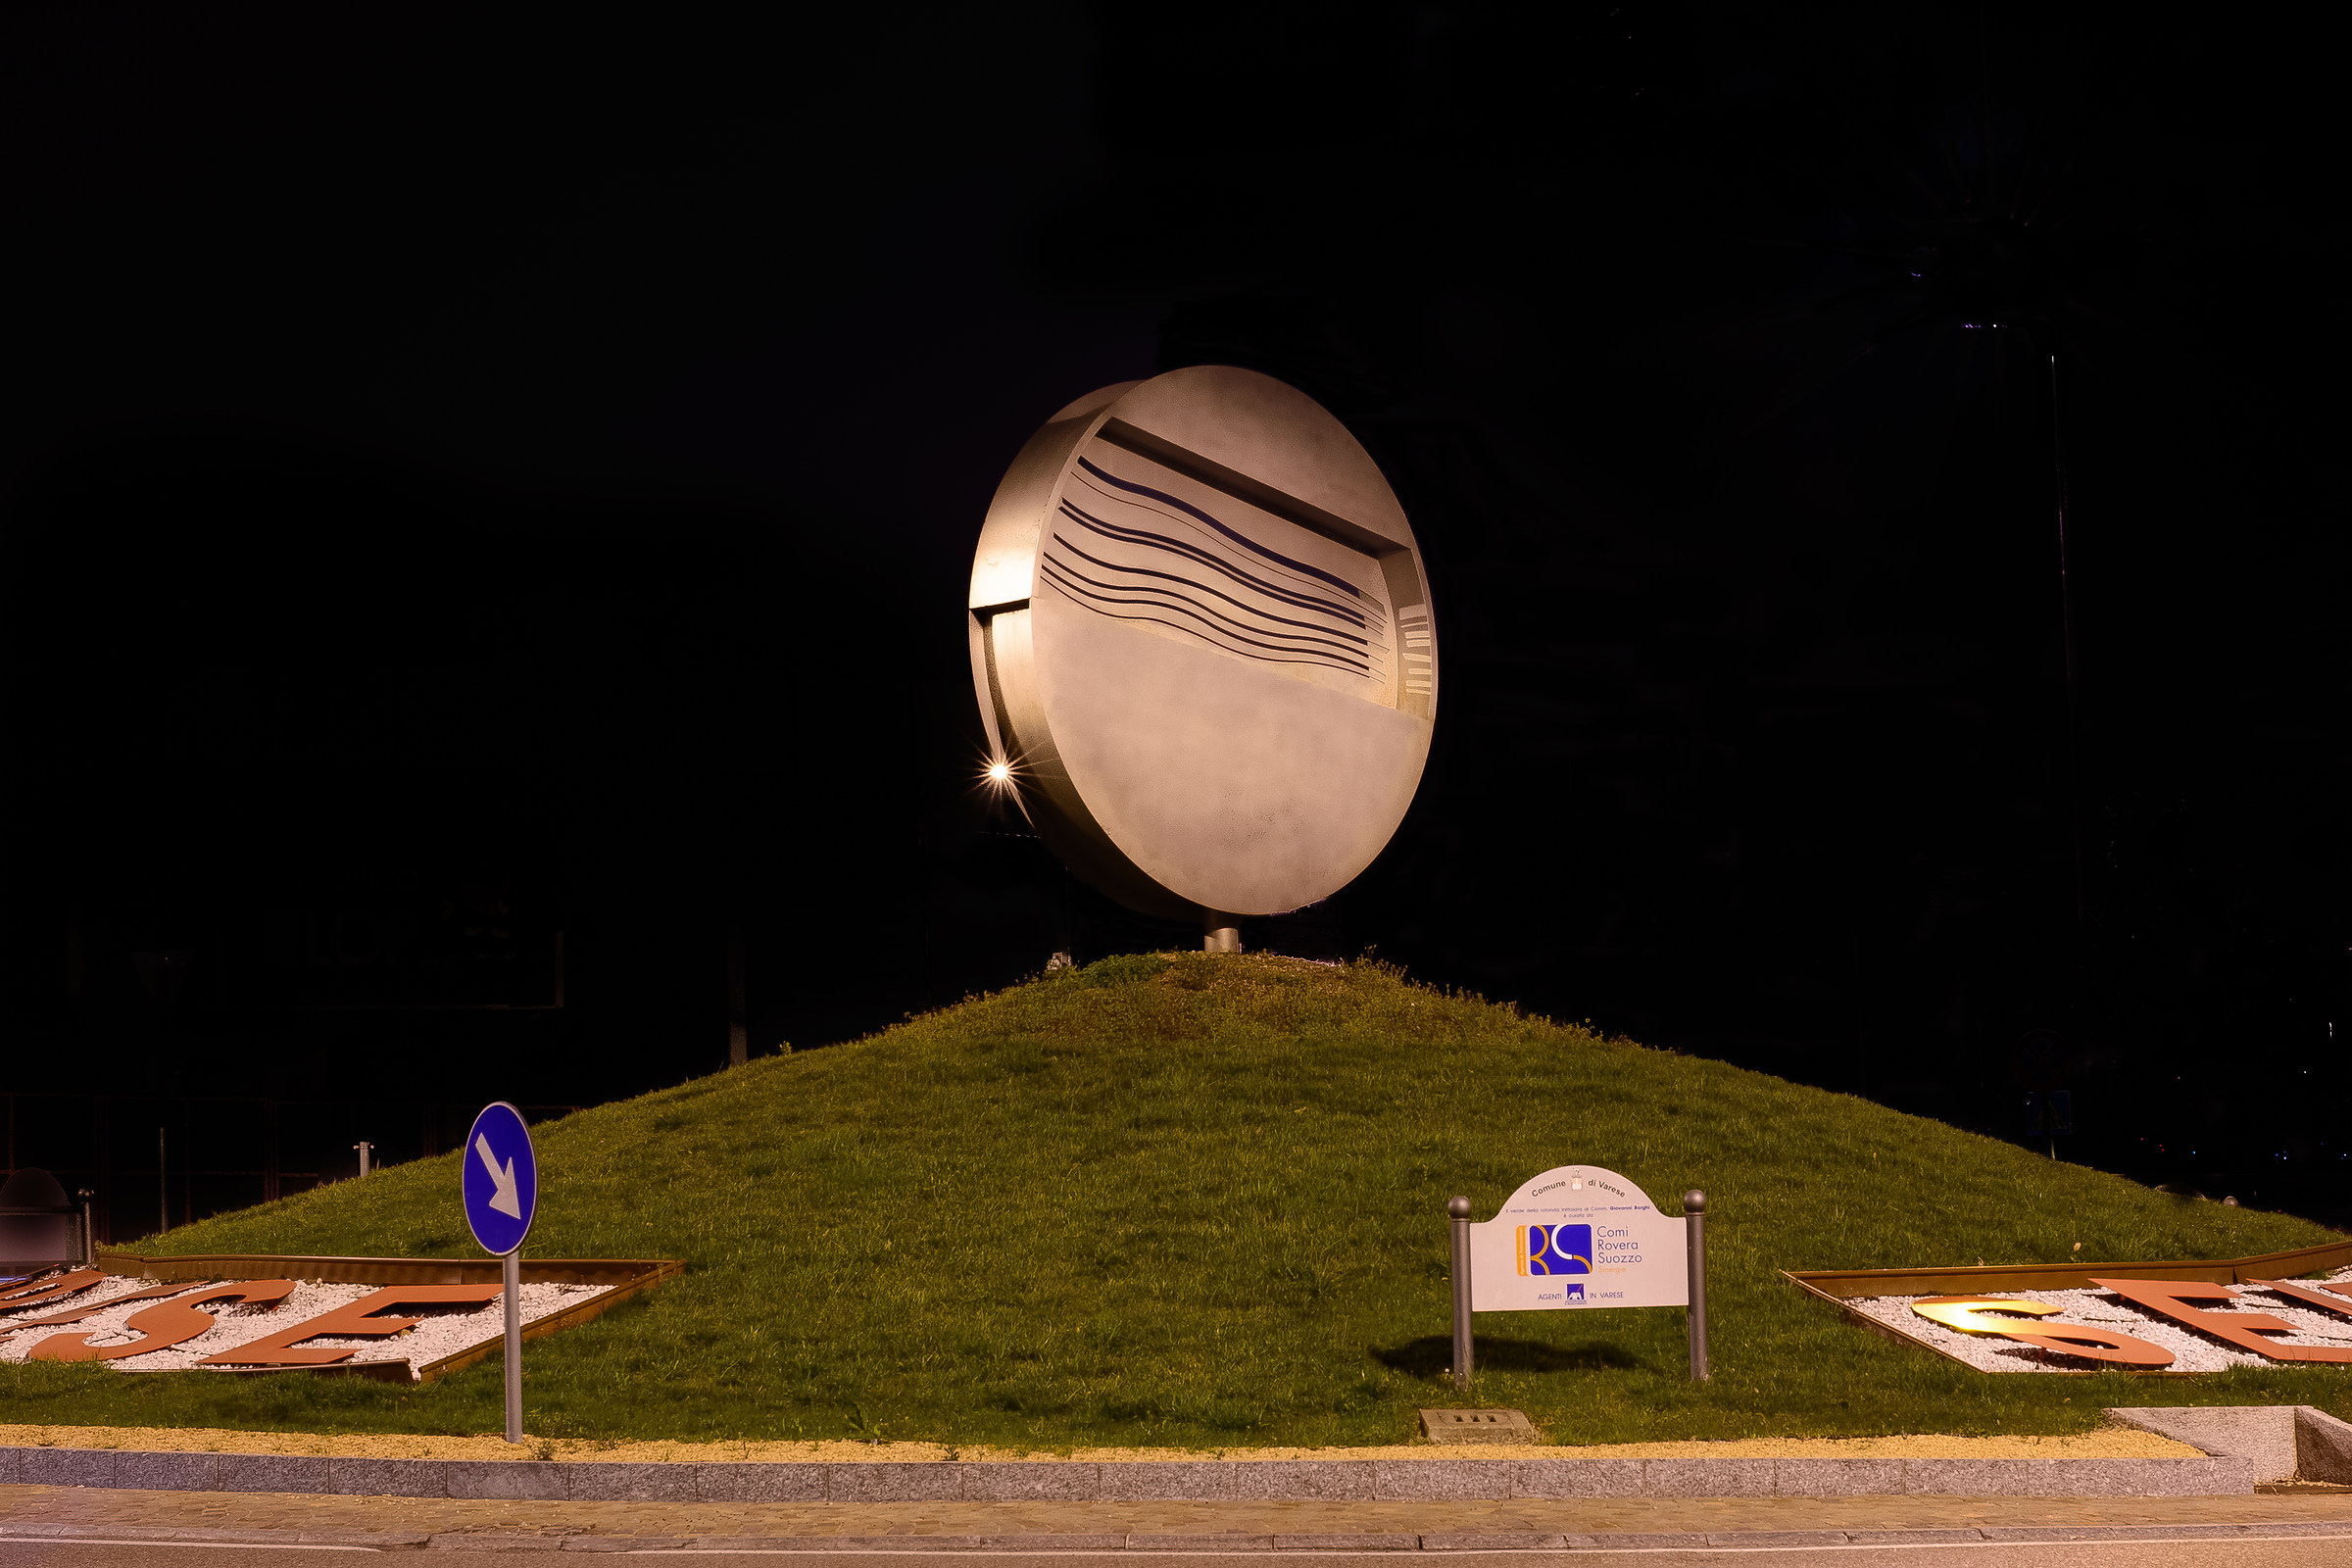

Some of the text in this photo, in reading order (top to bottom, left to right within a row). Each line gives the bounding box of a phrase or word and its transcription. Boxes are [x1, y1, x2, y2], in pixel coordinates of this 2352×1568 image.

[1531, 1180, 1566, 1198] Comune
[1598, 1181, 1626, 1198] Varese
[1597, 1226, 1629, 1238] Comi
[1597, 1239, 1639, 1250] Rovera
[1597, 1251, 1642, 1264] Suozzo
